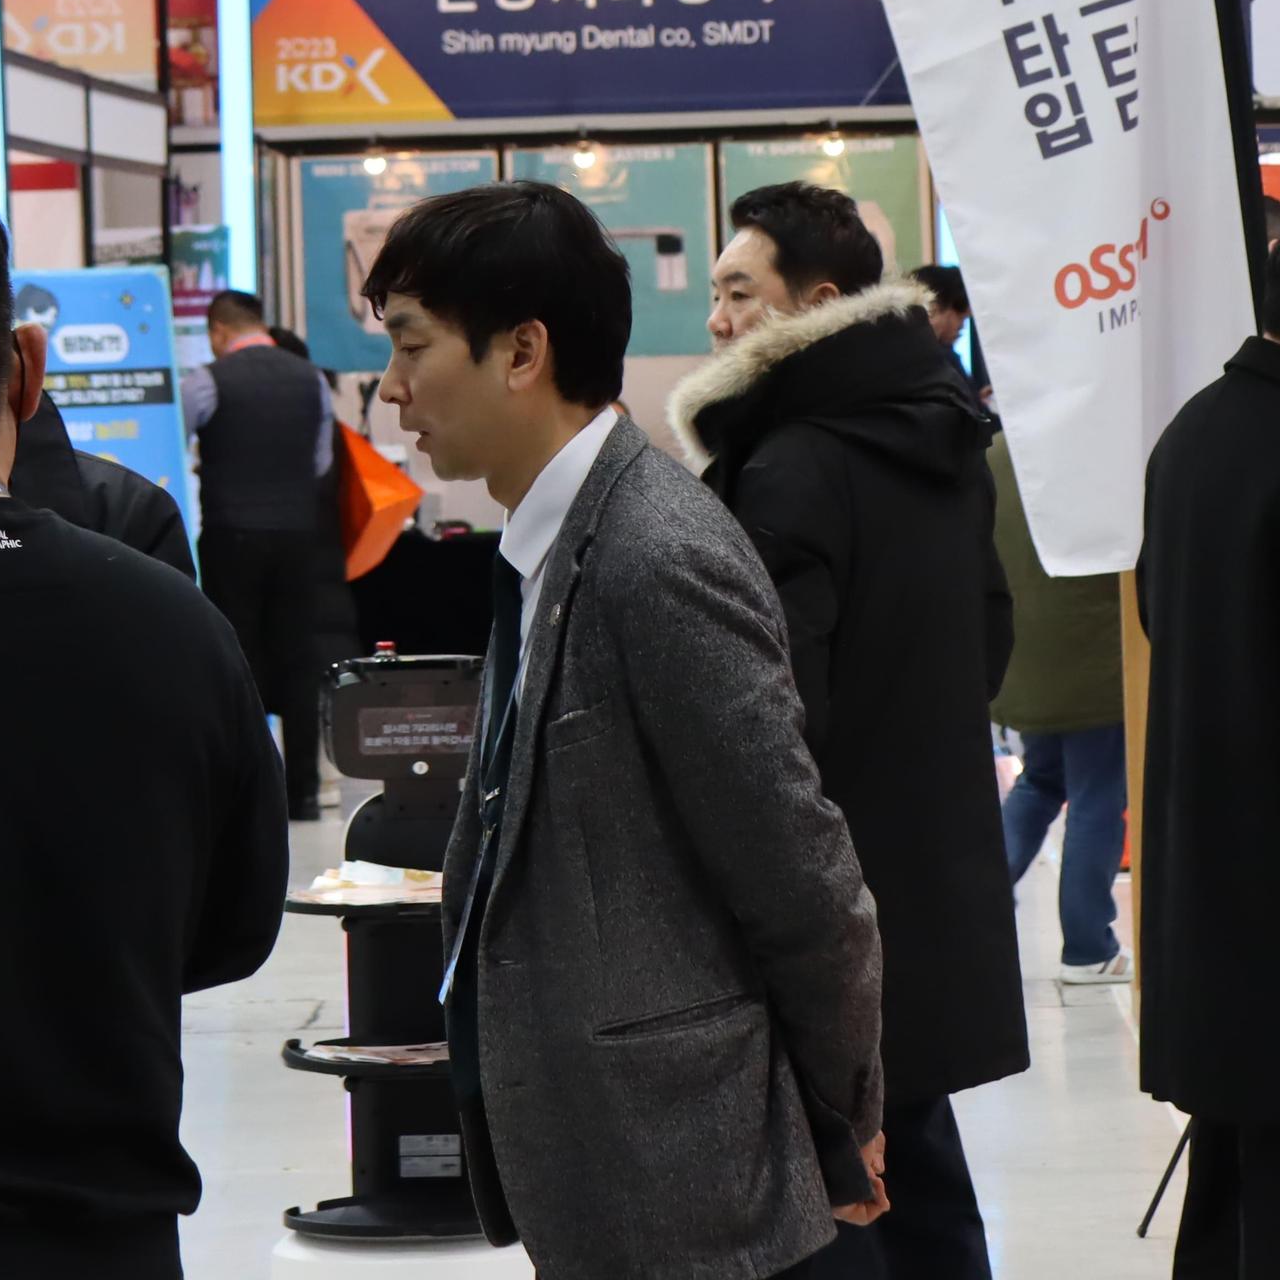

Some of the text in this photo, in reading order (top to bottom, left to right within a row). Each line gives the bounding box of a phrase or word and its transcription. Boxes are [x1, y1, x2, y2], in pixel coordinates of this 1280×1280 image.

[442, 29, 494, 54] Shin
[500, 31, 575, 56] myung
[582, 24, 655, 50] Dental
[703, 19, 776, 46] SMDT
[1002, 12, 1095, 161] 타입
